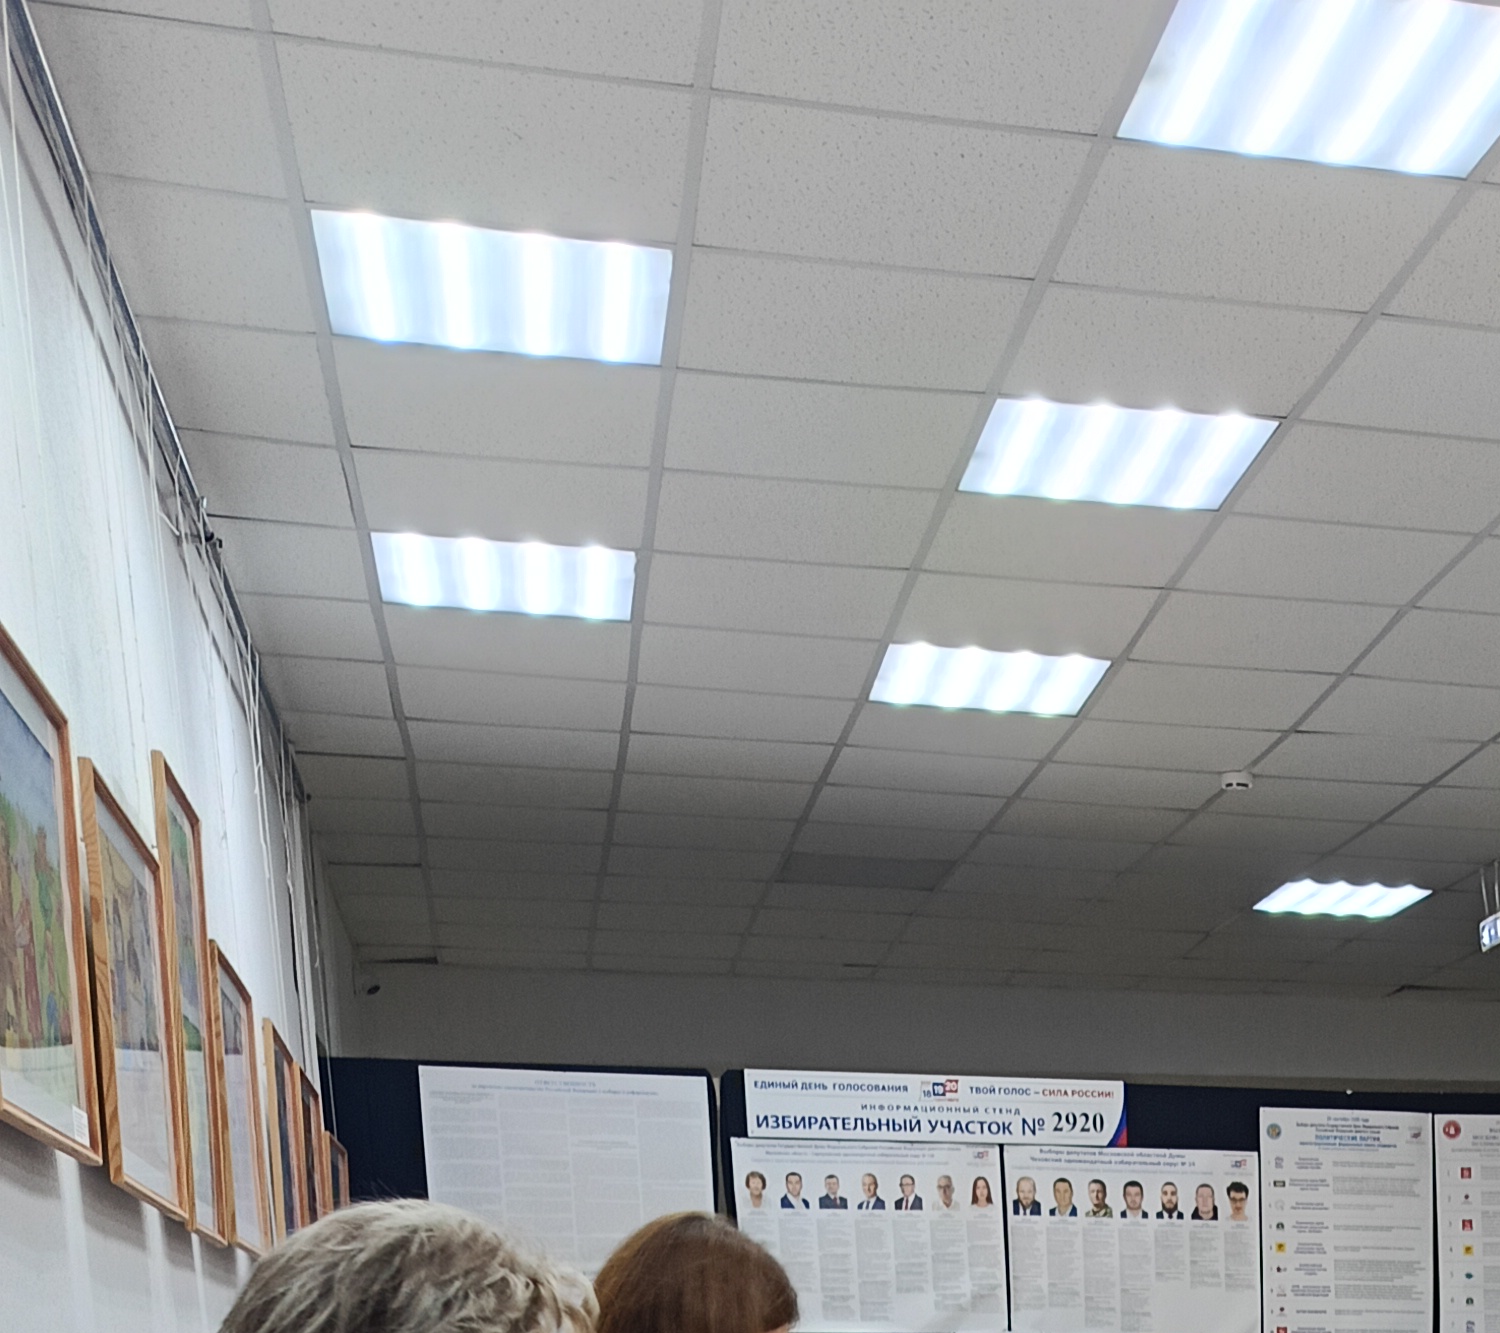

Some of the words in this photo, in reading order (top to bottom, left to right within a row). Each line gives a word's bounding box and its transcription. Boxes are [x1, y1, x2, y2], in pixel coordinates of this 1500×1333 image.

[754, 1080, 799, 1090] ЕДИНЫЙ
[800, 1082, 828, 1091] ДЕНЬ
[833, 1083, 908, 1092] ГОЛОСОВАНИЯ
[969, 1085, 996, 1095] ТВОЙ
[998, 1087, 1031, 1097] ГОЛОС
[1042, 1088, 1069, 1097] СИЛА
[1071, 1089, 1114, 1099] РОССИИ!
[861, 1103, 979, 1114] ИНФОРМАЦИОННЫЙ
[984, 1107, 1021, 1116] СТЕНД
[756, 1114, 922, 1133] ИЗБИРАТЕЛЬНЫЙ
[928, 1119, 1013, 1135] УЧАСТОК
[1022, 1117, 1045, 1136] №
[1052, 1111, 1105, 1134] 2920
